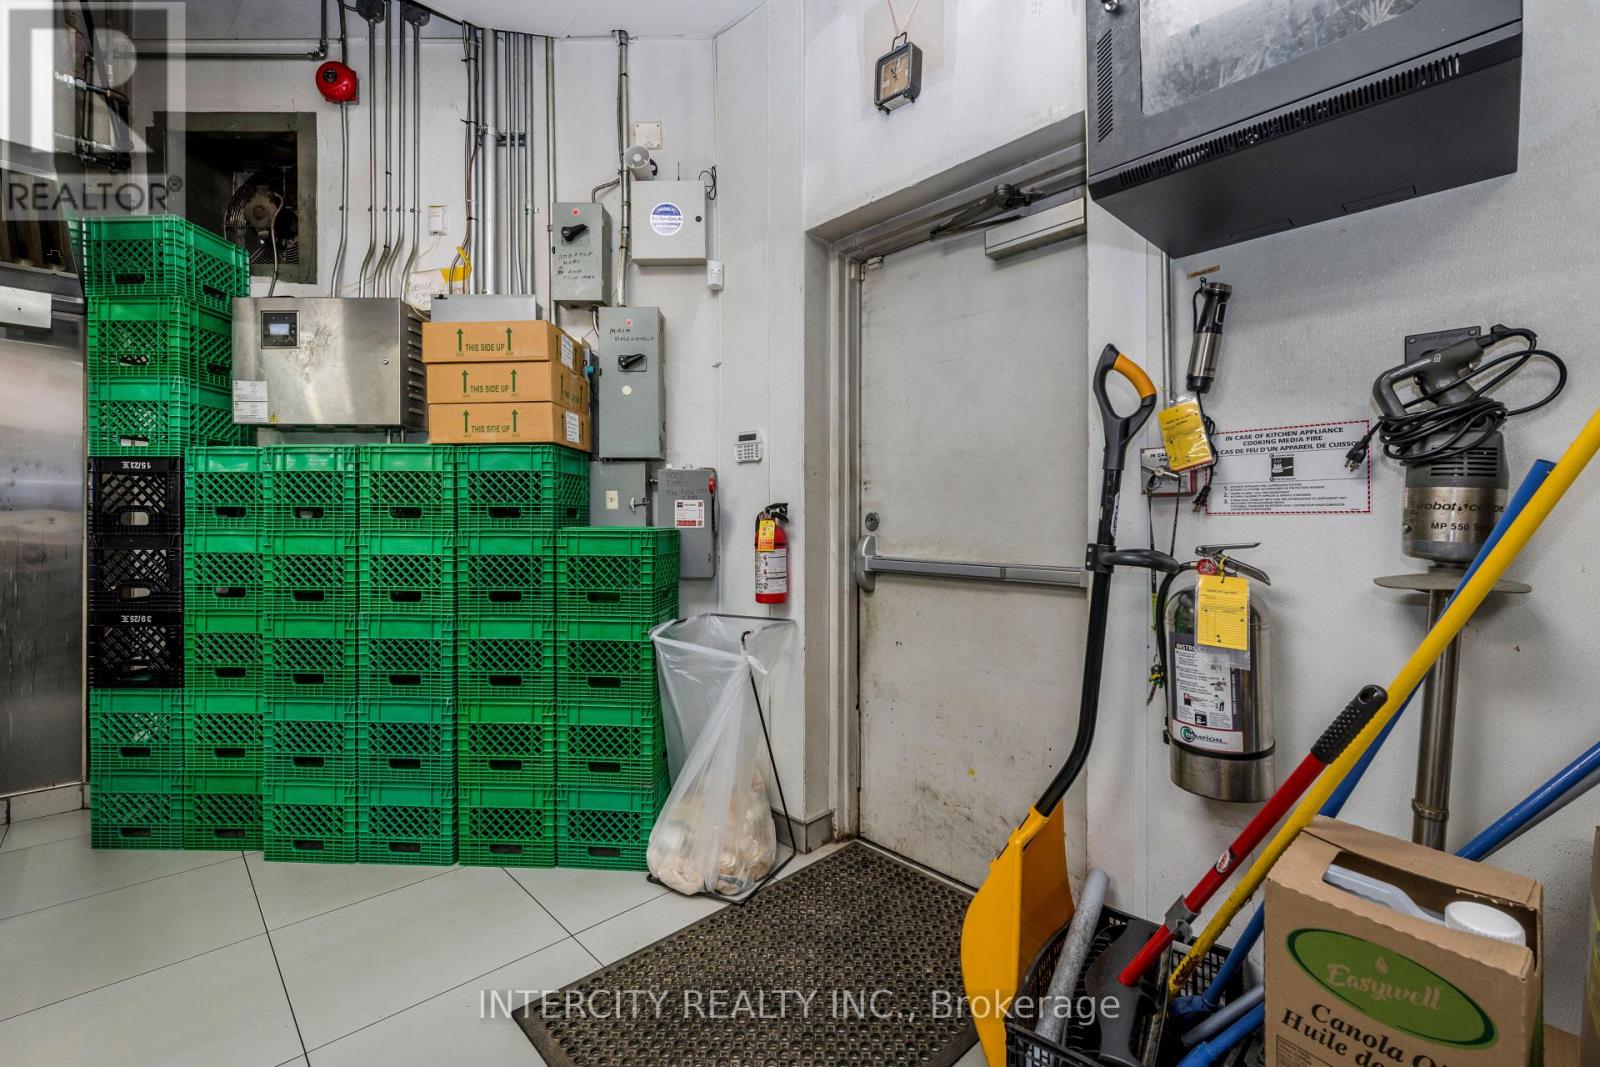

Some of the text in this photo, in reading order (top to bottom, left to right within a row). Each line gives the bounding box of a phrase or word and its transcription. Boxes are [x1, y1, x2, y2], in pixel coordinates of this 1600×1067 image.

[465, 343, 505, 352] THIS SIDE UP
[470, 385, 509, 393] THIS SIDE UP
[471, 425, 510, 433] THIS SIDE UP
[1266, 430, 1298, 439] KITCHEN
[1300, 427, 1344, 436] APPLIANCE
[1280, 444, 1314, 452] APPAREIL
[1418, 502, 1456, 511] robot
[1451, 523, 1470, 531] 550
[1326, 963, 1441, 1010] Easywell
[1281, 1007, 1348, 1056] Huile
[1311, 1003, 1404, 1063] Canola
